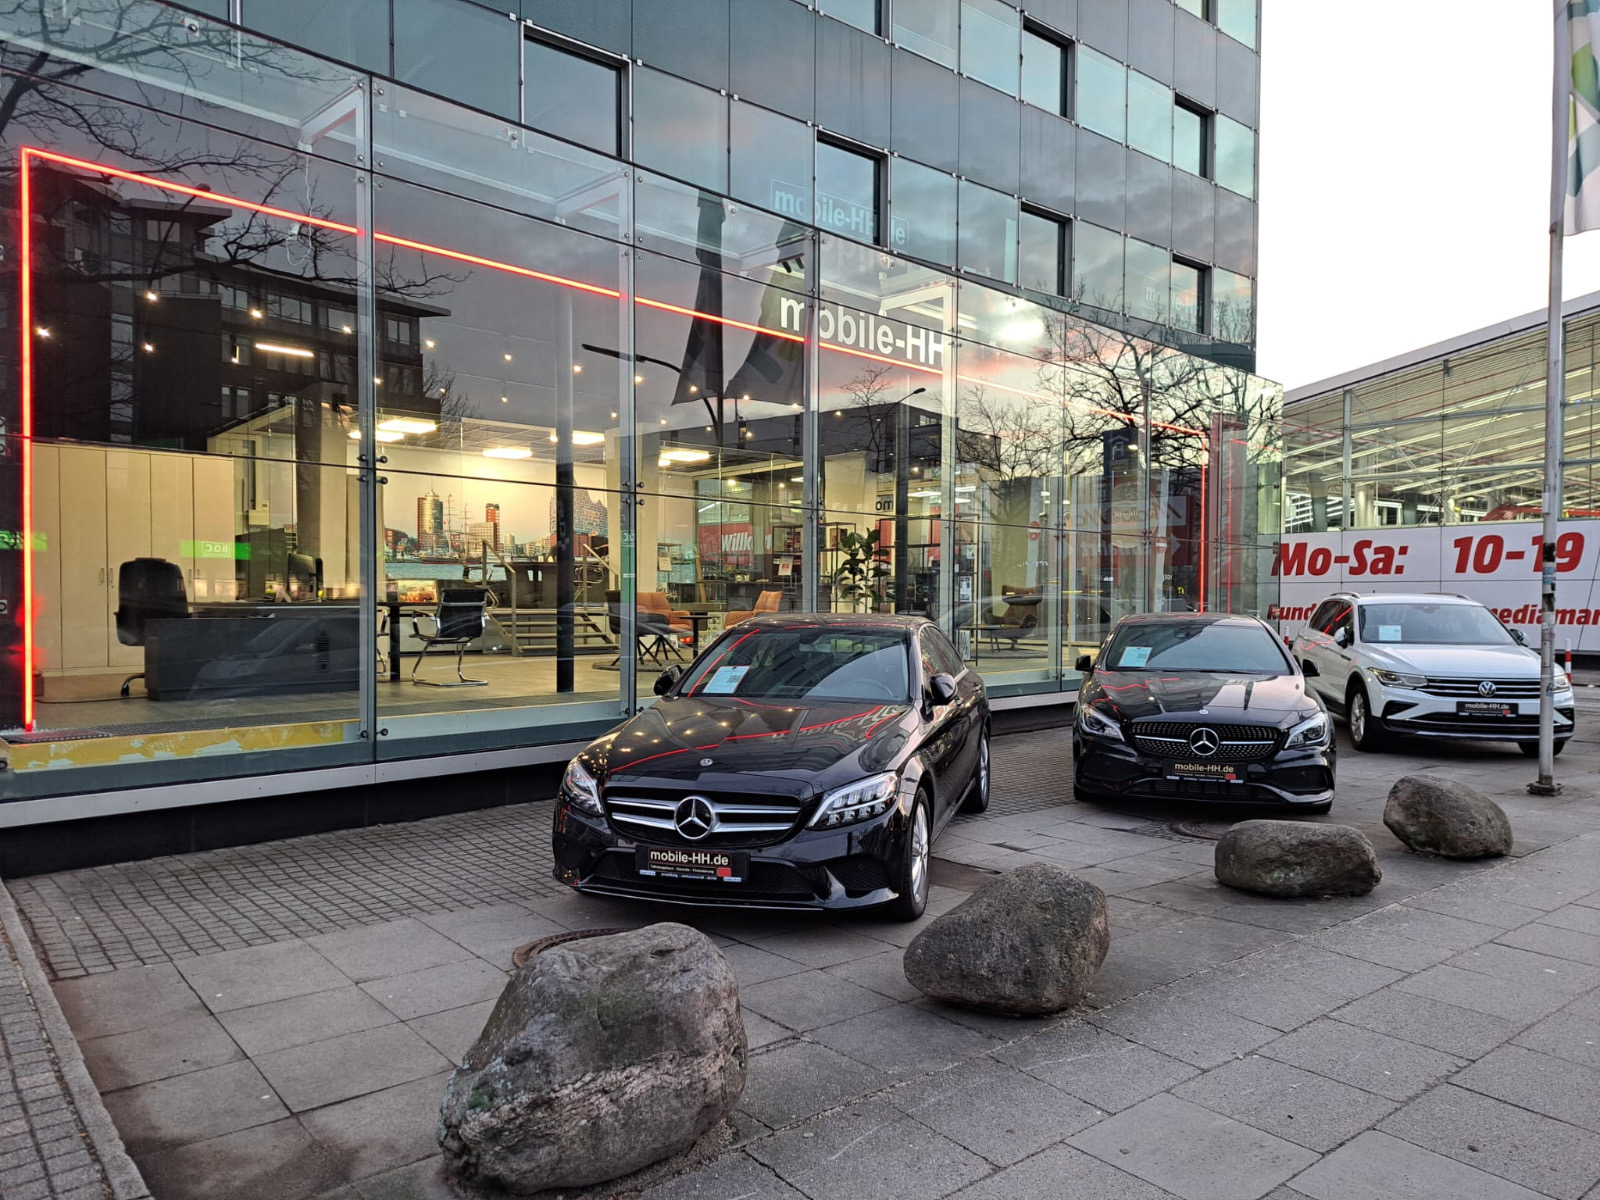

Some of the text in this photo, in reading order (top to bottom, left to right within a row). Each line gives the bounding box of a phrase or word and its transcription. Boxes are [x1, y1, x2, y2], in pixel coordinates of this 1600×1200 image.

[774, 190, 906, 246] moile-HHe
[780, 296, 944, 368] mobile-HH
[1271, 532, 1585, 577] Mo-Sa: 10-19
[1174, 763, 1235, 773] mobile-HH.de
[650, 850, 729, 866] mobile-HH.de
